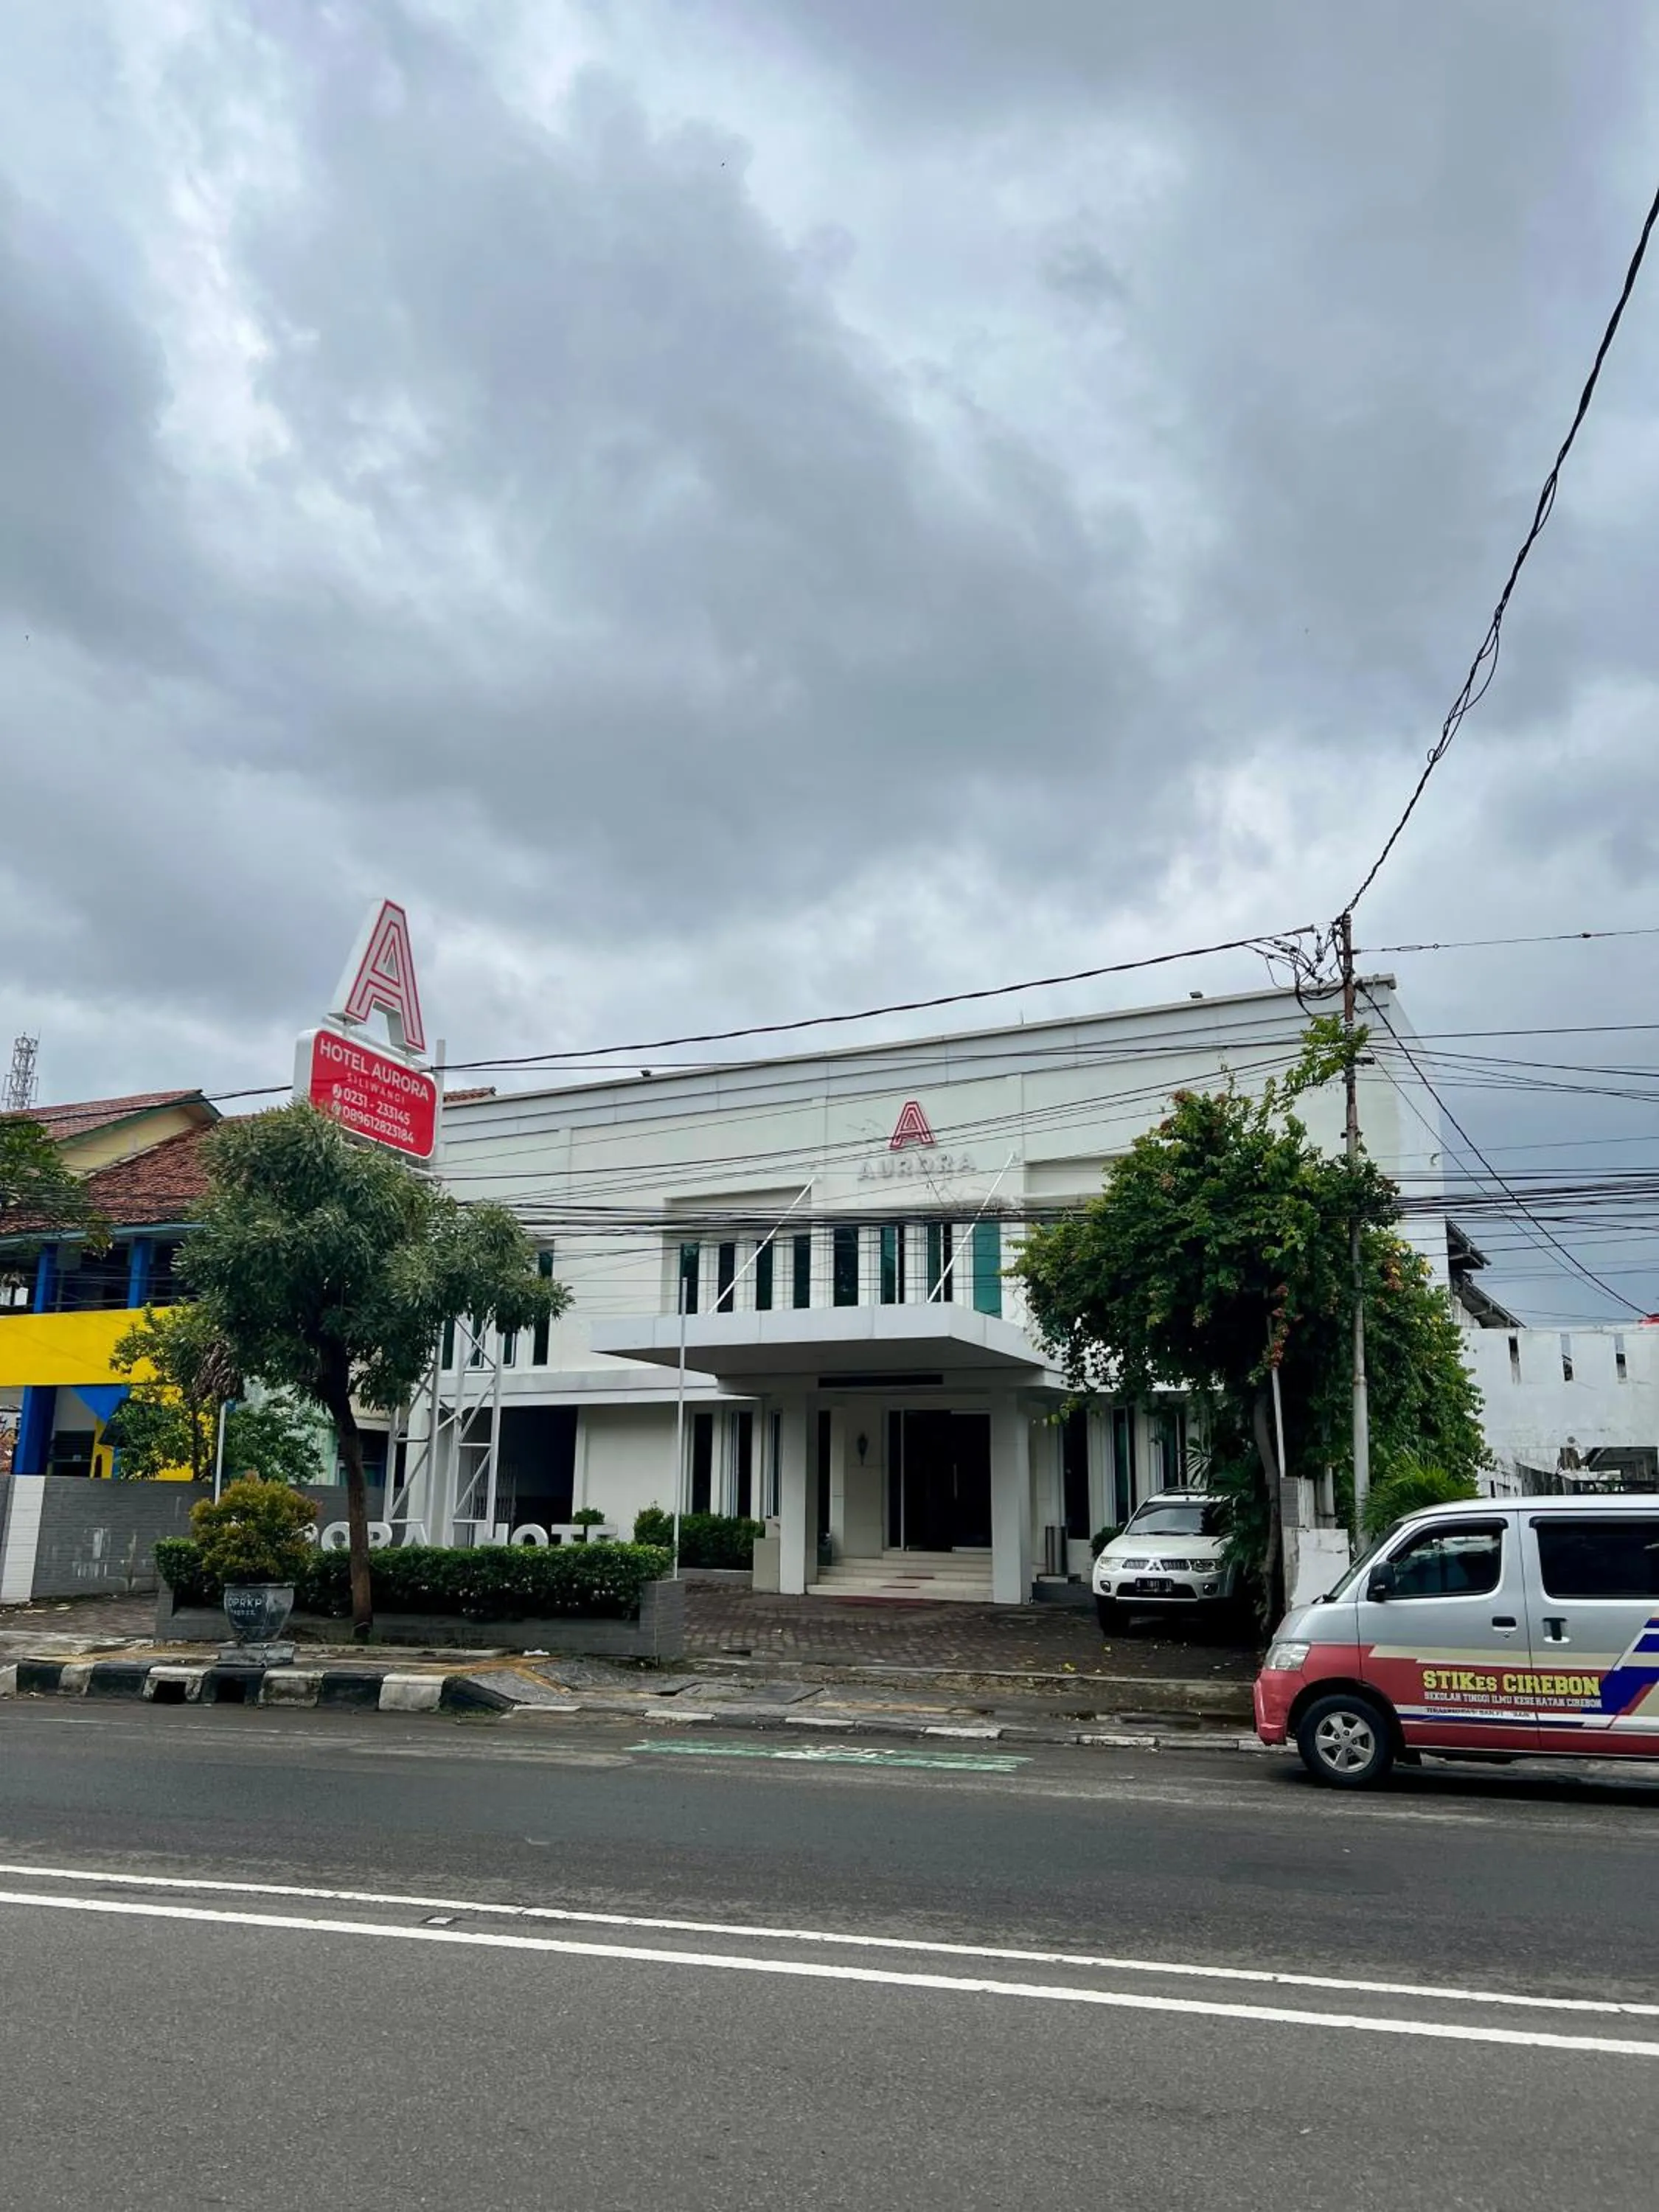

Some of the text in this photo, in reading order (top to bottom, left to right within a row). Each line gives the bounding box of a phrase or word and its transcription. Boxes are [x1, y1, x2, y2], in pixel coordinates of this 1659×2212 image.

[320, 1038, 429, 1102] HOTEL AURORA
[346, 1073, 405, 1105] SILIWANGI
[344, 1088, 368, 1107] 0231
[377, 1101, 411, 1126] 233145
[858, 1152, 977, 1181] AURORA
[1492, 1695, 1512, 1704] ILMU
[1503, 1674, 1601, 1697] CIREBON
